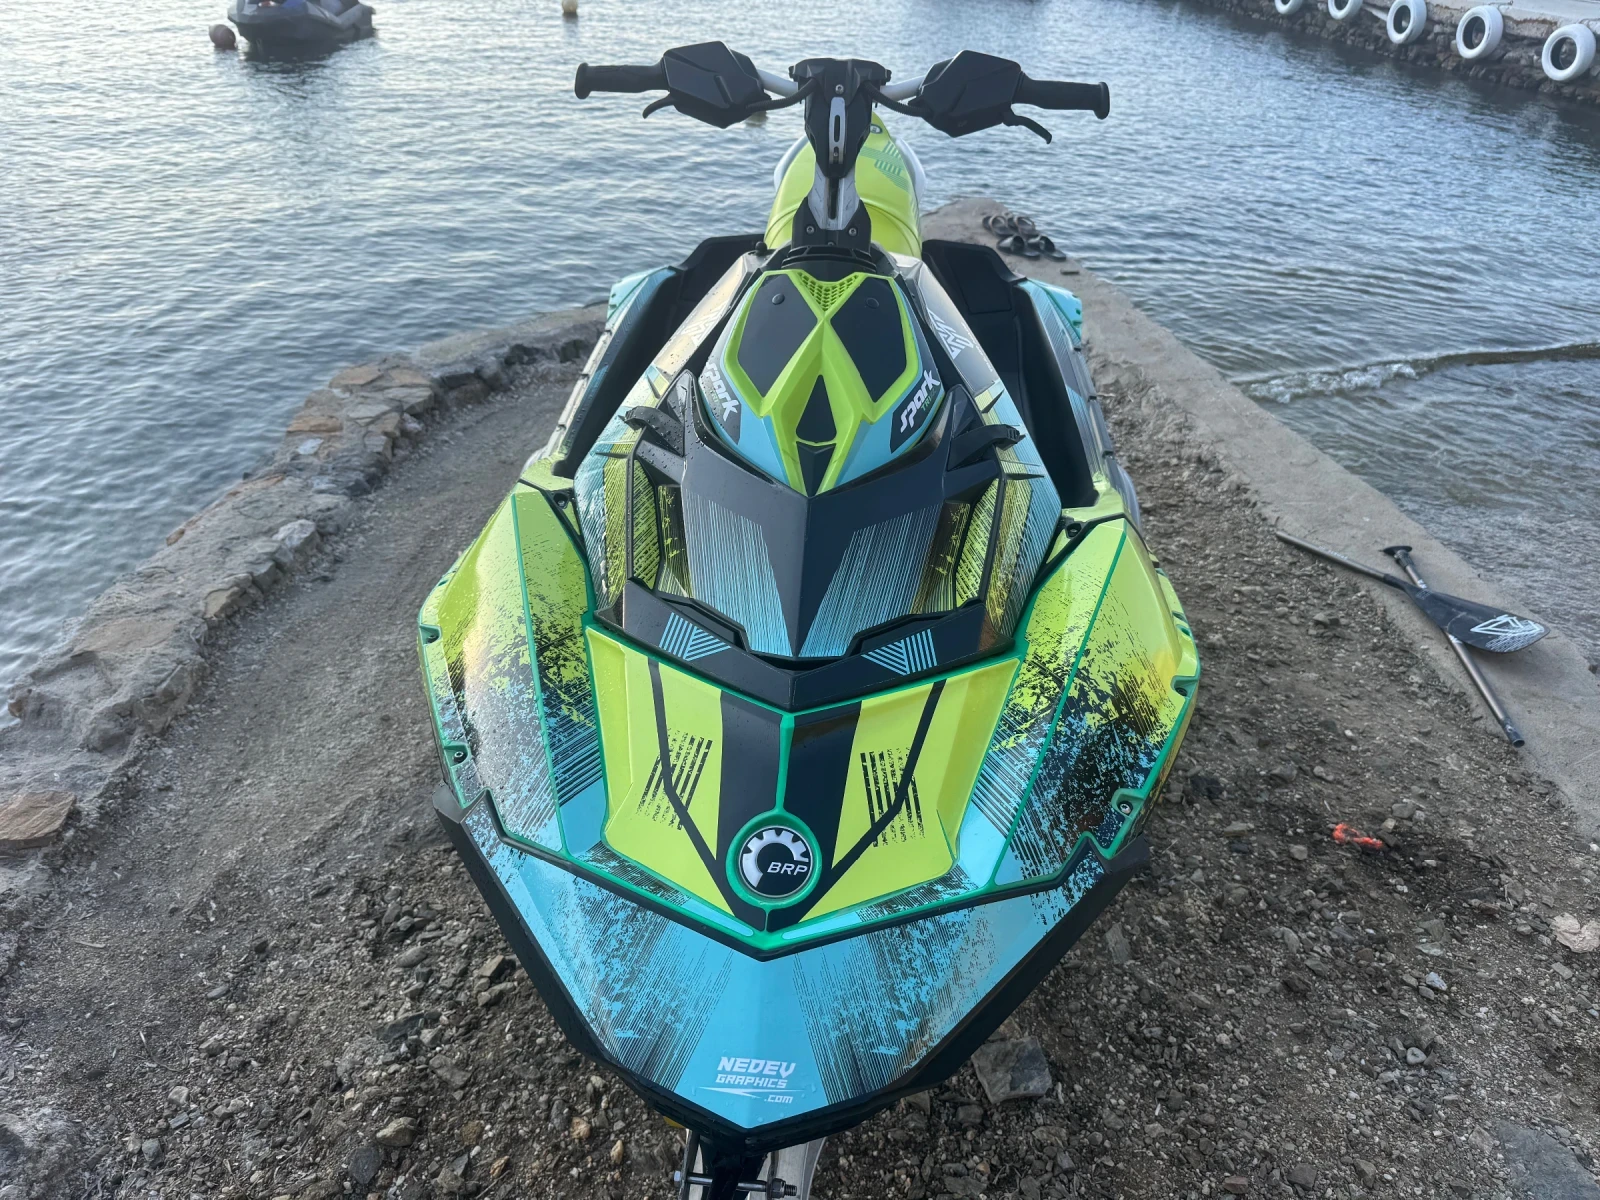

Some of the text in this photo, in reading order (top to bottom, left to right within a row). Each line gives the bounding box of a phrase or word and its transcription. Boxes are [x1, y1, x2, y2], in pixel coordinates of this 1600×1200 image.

[767, 861, 808, 876] BRP
[717, 1056, 796, 1079] NEDEV
[715, 1073, 788, 1089] GRAPHICS
